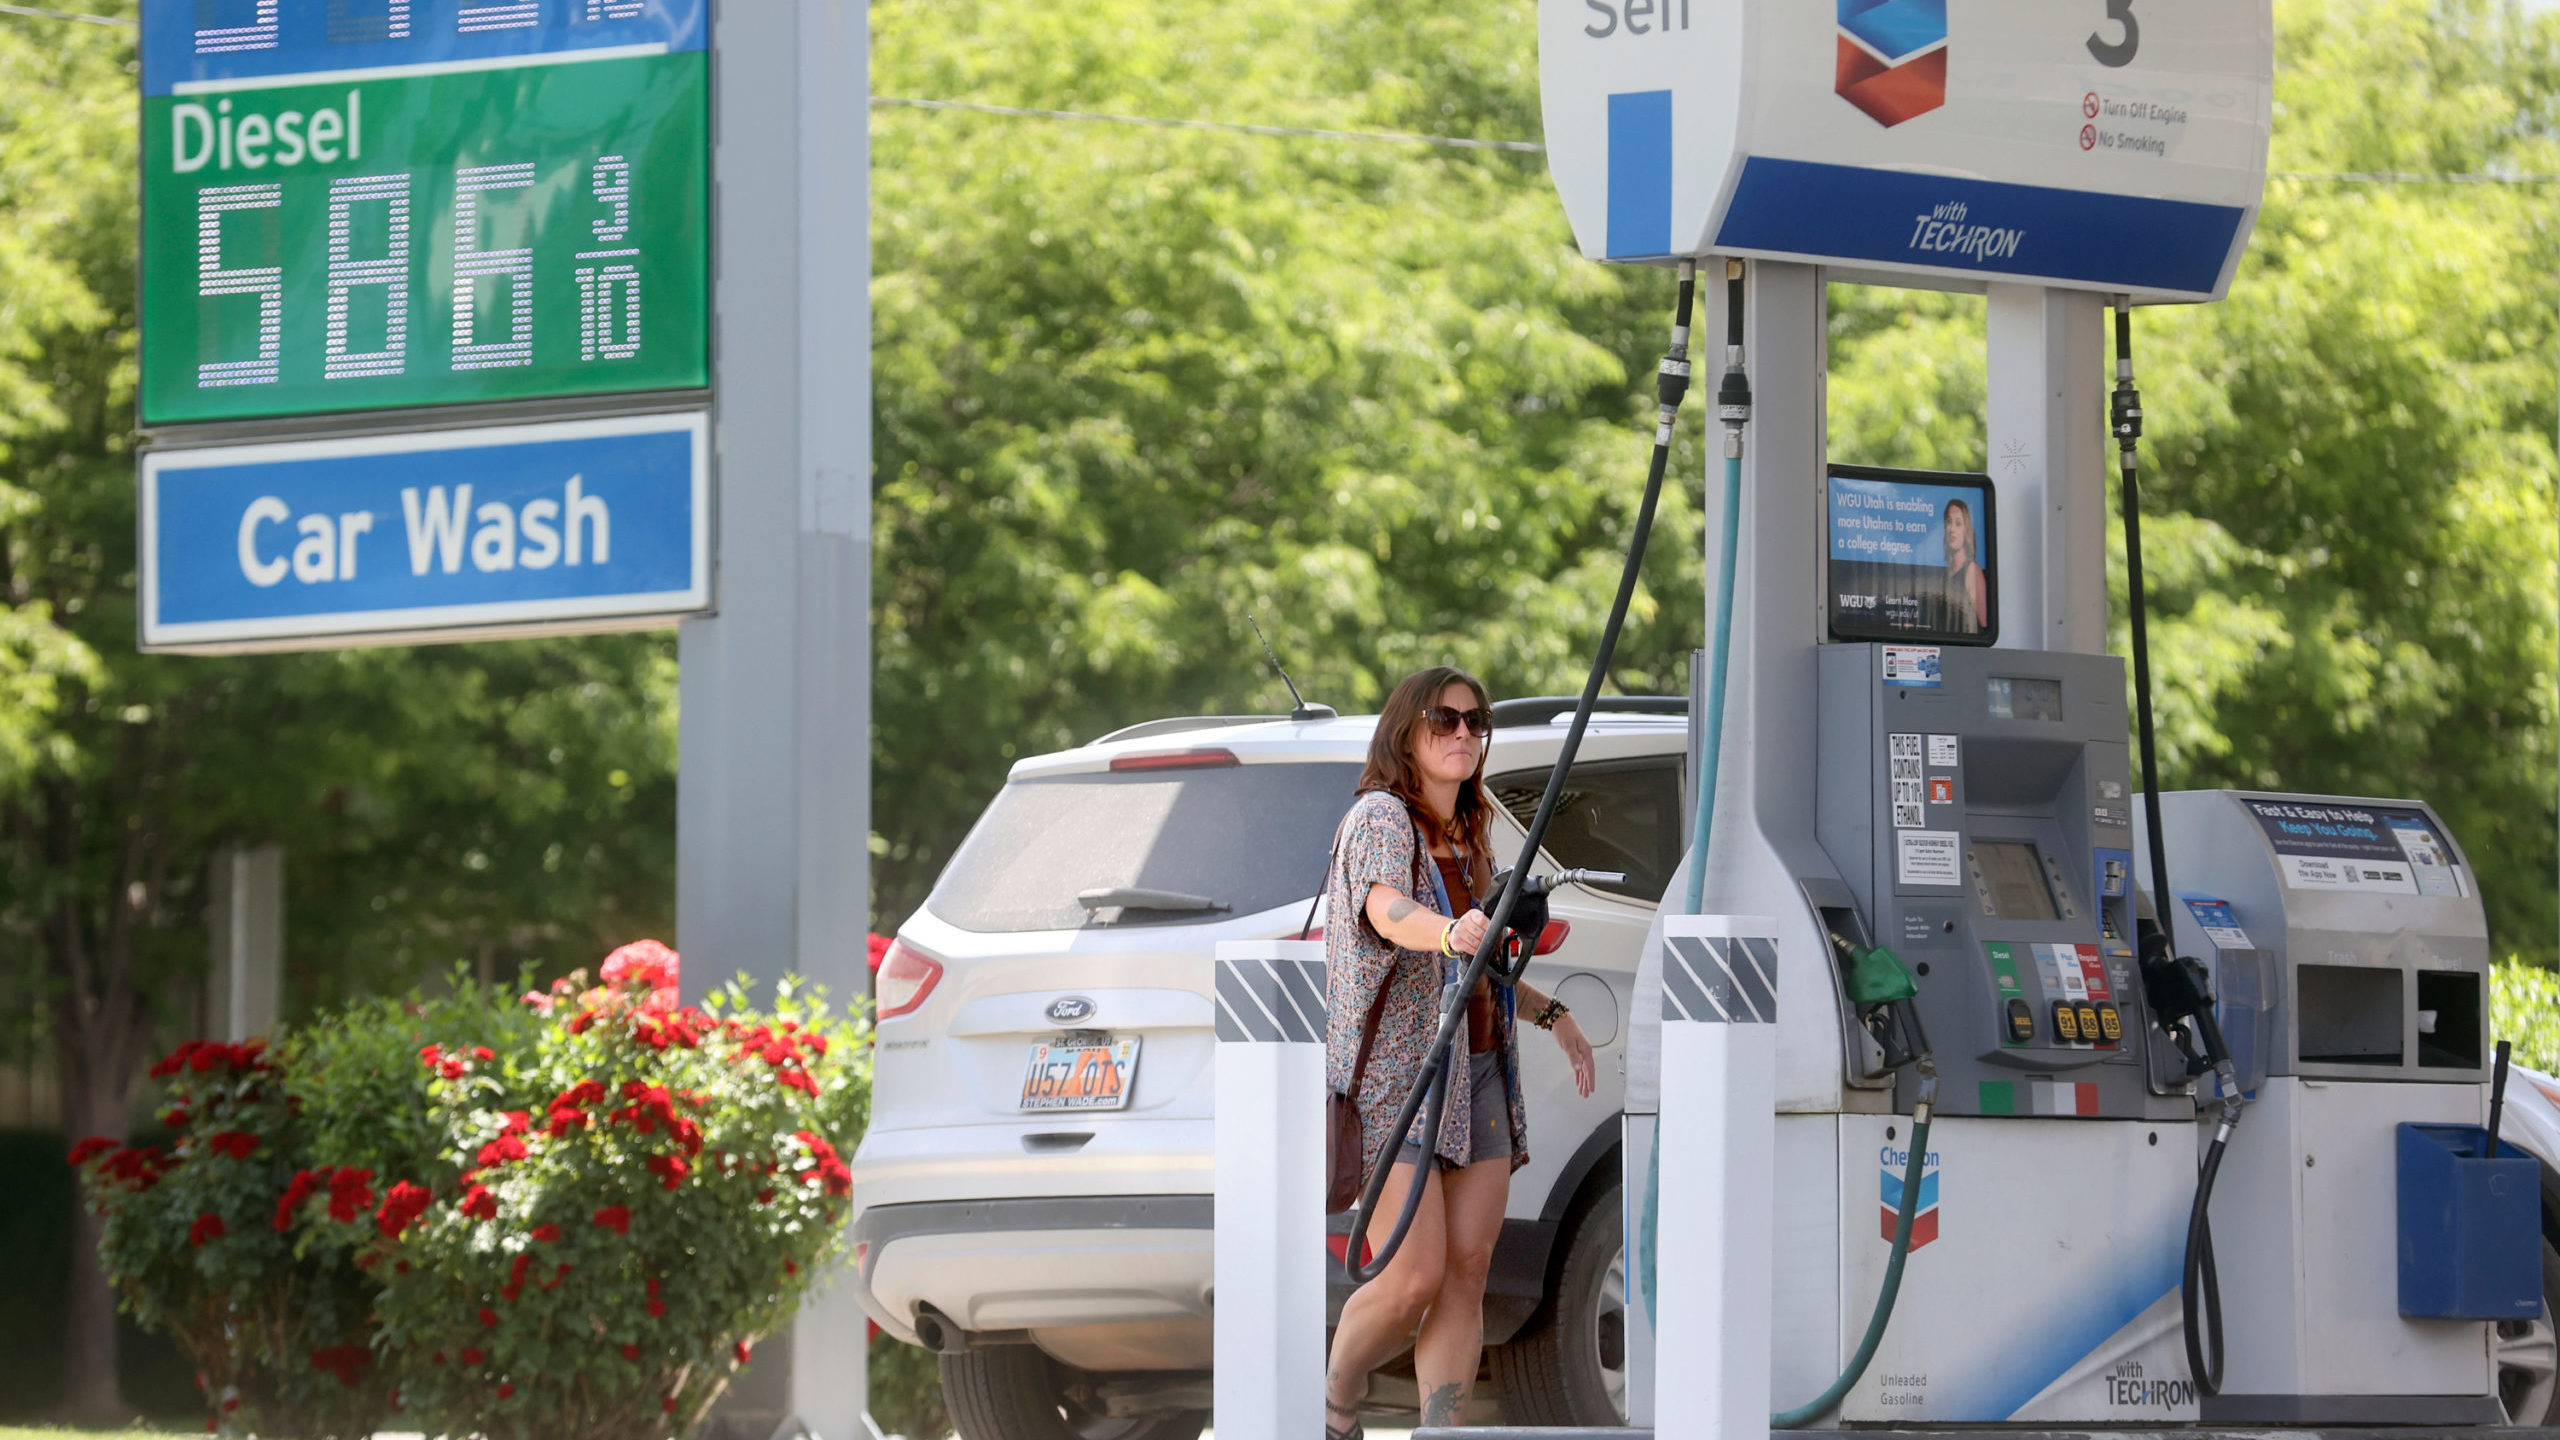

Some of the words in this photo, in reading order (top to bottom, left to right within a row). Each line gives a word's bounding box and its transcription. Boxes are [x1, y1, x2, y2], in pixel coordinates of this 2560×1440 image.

[2086, 0, 2140, 68] 3
[2102, 98, 2127, 117] Turn
[2130, 102, 2149, 119] Off
[2150, 104, 2187, 126] Engine
[172, 89, 361, 174] Diesel
[2099, 130, 2115, 149] No
[2117, 132, 2165, 157] Smoking
[1932, 200, 1968, 222] with
[1908, 214, 2024, 262] TECHRON
[197, 162, 537, 389] 586
[1836, 493, 1861, 508] WGU
[1863, 494, 1884, 509] Utah
[1886, 496, 1894, 510] is
[1896, 497, 1935, 517] enabling
[237, 496, 374, 588] Car
[400, 473, 611, 577] Wash
[1837, 517, 1860, 528] more
[1862, 515, 1893, 531] Utahns
[1895, 519, 1904, 531] to
[1906, 522, 1927, 533] earn
[1838, 538, 1845, 548] a
[1847, 534, 1878, 554] college
[1880, 536, 1913, 555] degree.
[1840, 594, 1863, 608] WGU
[1892, 736, 1904, 756] THIS
[1906, 736, 1920, 756] FUEL
[1893, 758, 1920, 779] CONTAINS
[1893, 782, 1901, 802] UP
[1902, 782, 1910, 802] TO
[1896, 805, 1922, 826] ETHANOL
[2253, 804, 2282, 817] Fast
[2294, 807, 2330, 822] Easy
[2329, 809, 2343, 822] to
[2342, 810, 2374, 824] Help
[2278, 820, 2312, 837] Keep
[2310, 822, 2338, 836] You
[2061, 1016, 2075, 1030] 91
[2105, 1017, 2119, 1031] 85
[1039, 1046, 1047, 1059] 9
[1028, 1062, 1072, 1096] U57
[1022, 1096, 1066, 1109] STEPHEN
[1067, 1095, 1117, 1107] WADE.com
[1880, 1146, 1940, 1167] Cheon
[2116, 1361, 2143, 1378] with
[1880, 1374, 1927, 1387] Unleaded
[1880, 1392, 1924, 1406] Gasoline
[2106, 1375, 2194, 1412] TECHRON
